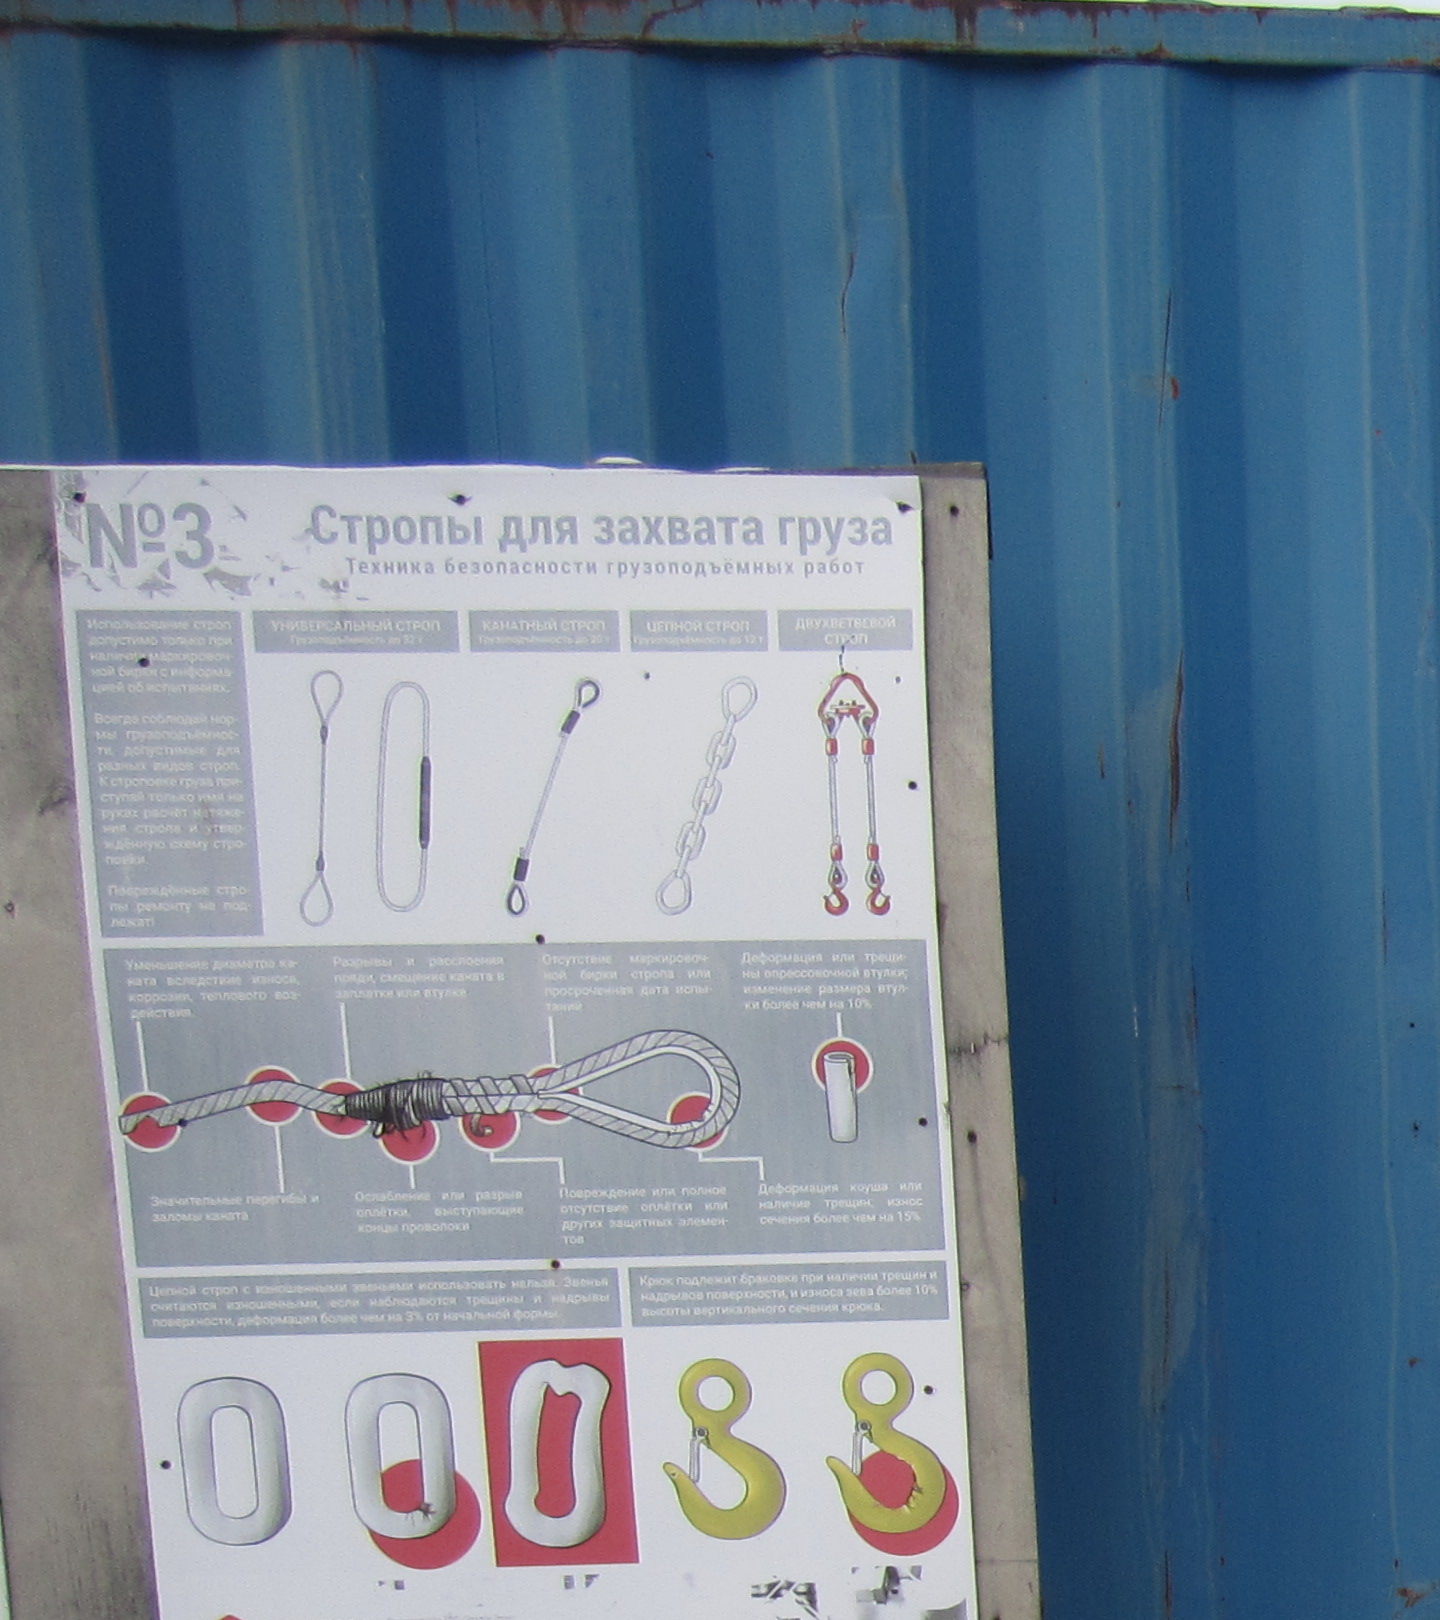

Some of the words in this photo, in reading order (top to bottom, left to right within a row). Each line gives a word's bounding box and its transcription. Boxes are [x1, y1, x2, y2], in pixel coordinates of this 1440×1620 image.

[311, 504, 483, 555] Стропы
[499, 514, 578, 553] для
[594, 514, 765, 547] захвата
[778, 514, 893, 556] груза
[346, 556, 435, 575] Техника
[445, 555, 597, 575] безопасности
[607, 559, 795, 579] грузоподъёмных
[803, 558, 864, 578] работ
[271, 619, 393, 632] УНИВЕРСАЛЬНЫЙ
[396, 620, 440, 632] СТРОП
[483, 618, 557, 632] КАНАТНЫЙ
[562, 620, 605, 631] СТРОП
[647, 619, 701, 634] ЦЕПНОЙ
[707, 620, 749, 632] СТРОП
[795, 616, 896, 630] ДВУХВЕТВЕВОЙ
[824, 633, 868, 645] СТРОП
[758, 1183, 839, 1196] Деформация
